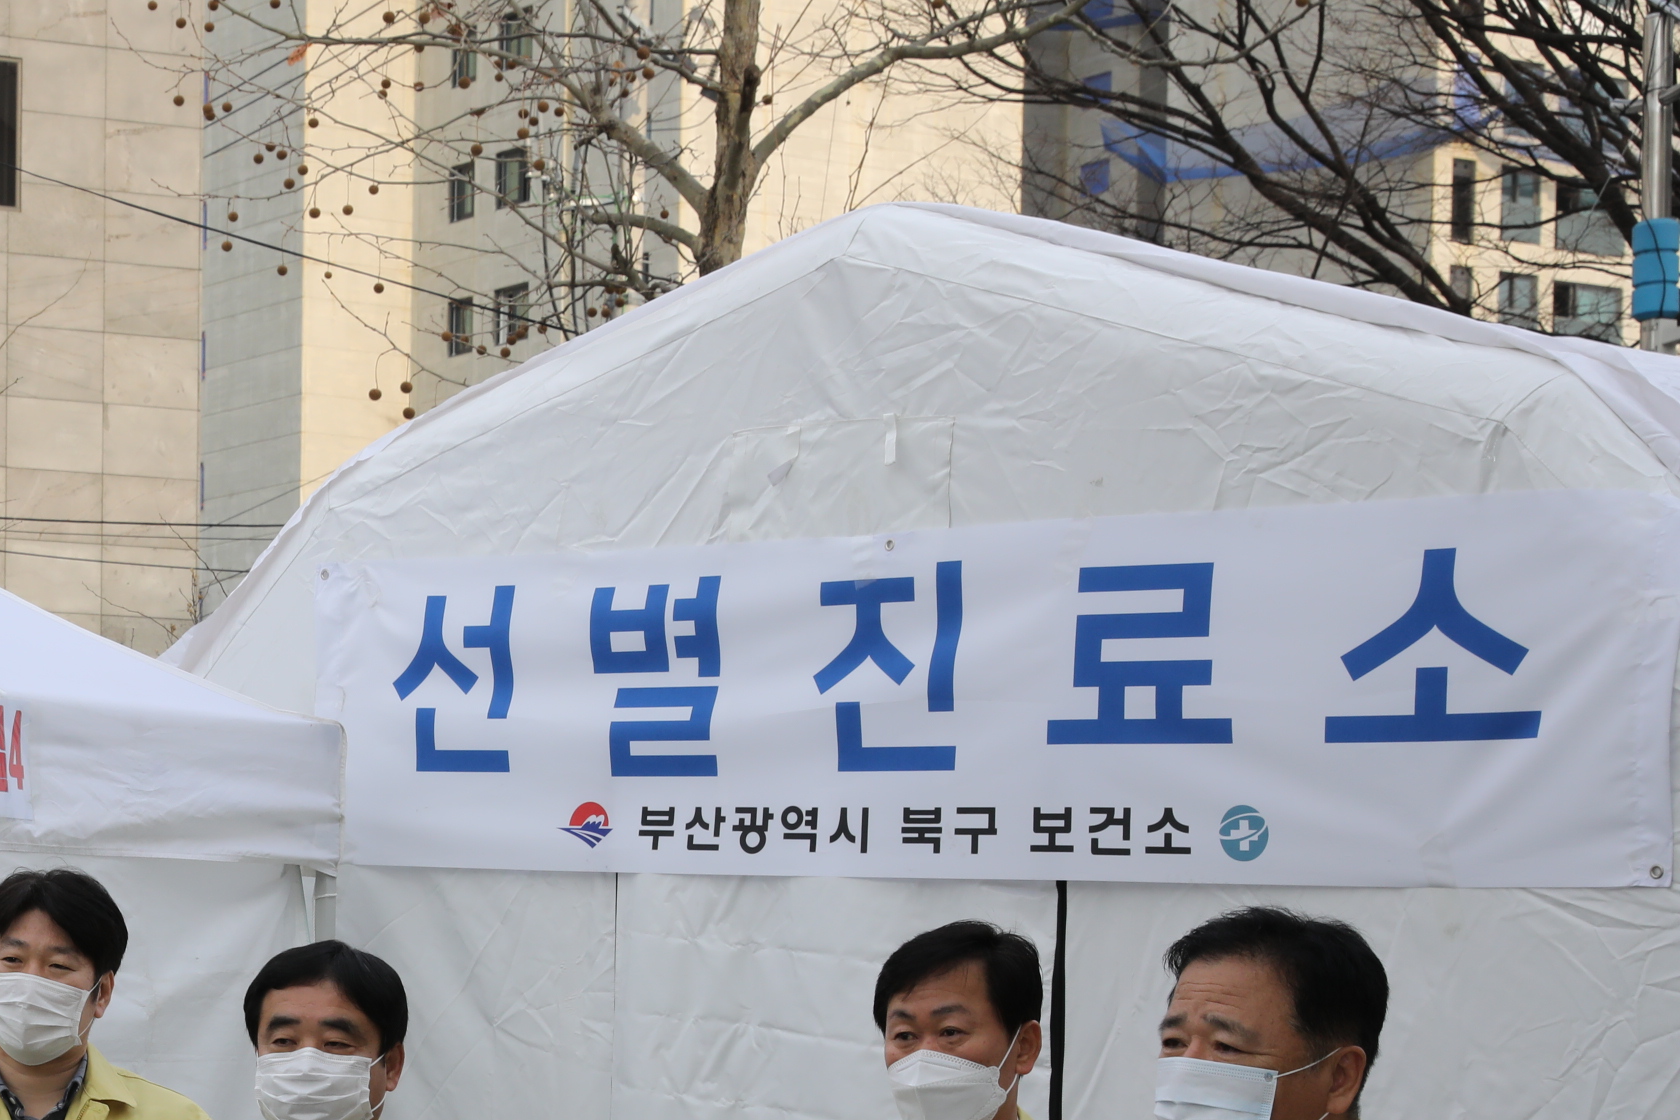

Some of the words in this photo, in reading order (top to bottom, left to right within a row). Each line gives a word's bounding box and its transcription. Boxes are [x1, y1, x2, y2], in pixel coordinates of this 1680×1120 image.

[638, 806, 870, 855] 부산광역시
[901, 807, 999, 855] 북구
[1029, 806, 1192, 856] 보건소
